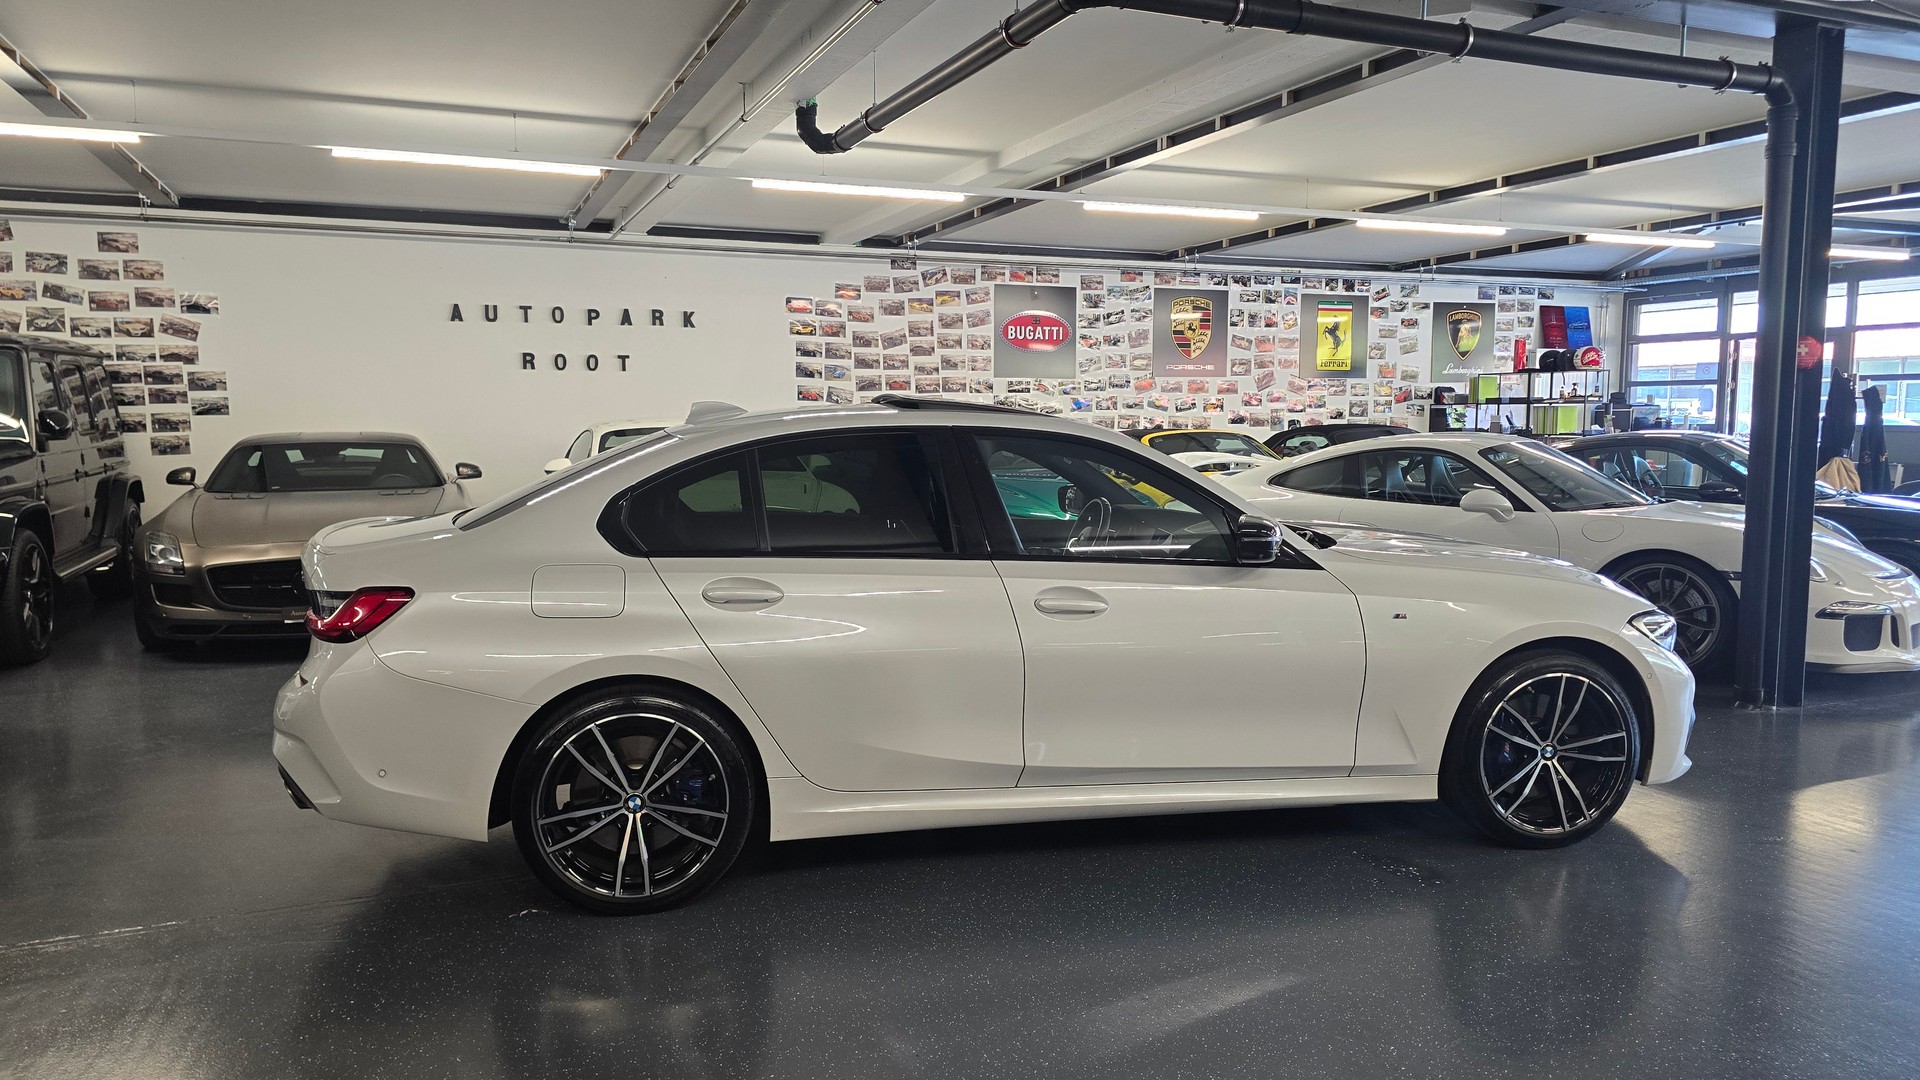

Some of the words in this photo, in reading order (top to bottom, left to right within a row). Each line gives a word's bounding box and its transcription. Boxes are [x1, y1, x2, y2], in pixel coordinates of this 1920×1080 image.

[1173, 299, 1211, 308] PORSCHE
[450, 303, 696, 328] AUTOPARK
[1007, 325, 1063, 340] BUGATTI
[522, 352, 630, 371] ROOT
[1320, 358, 1348, 368] Ferrari
[1442, 363, 1484, 376] Lamborghini
